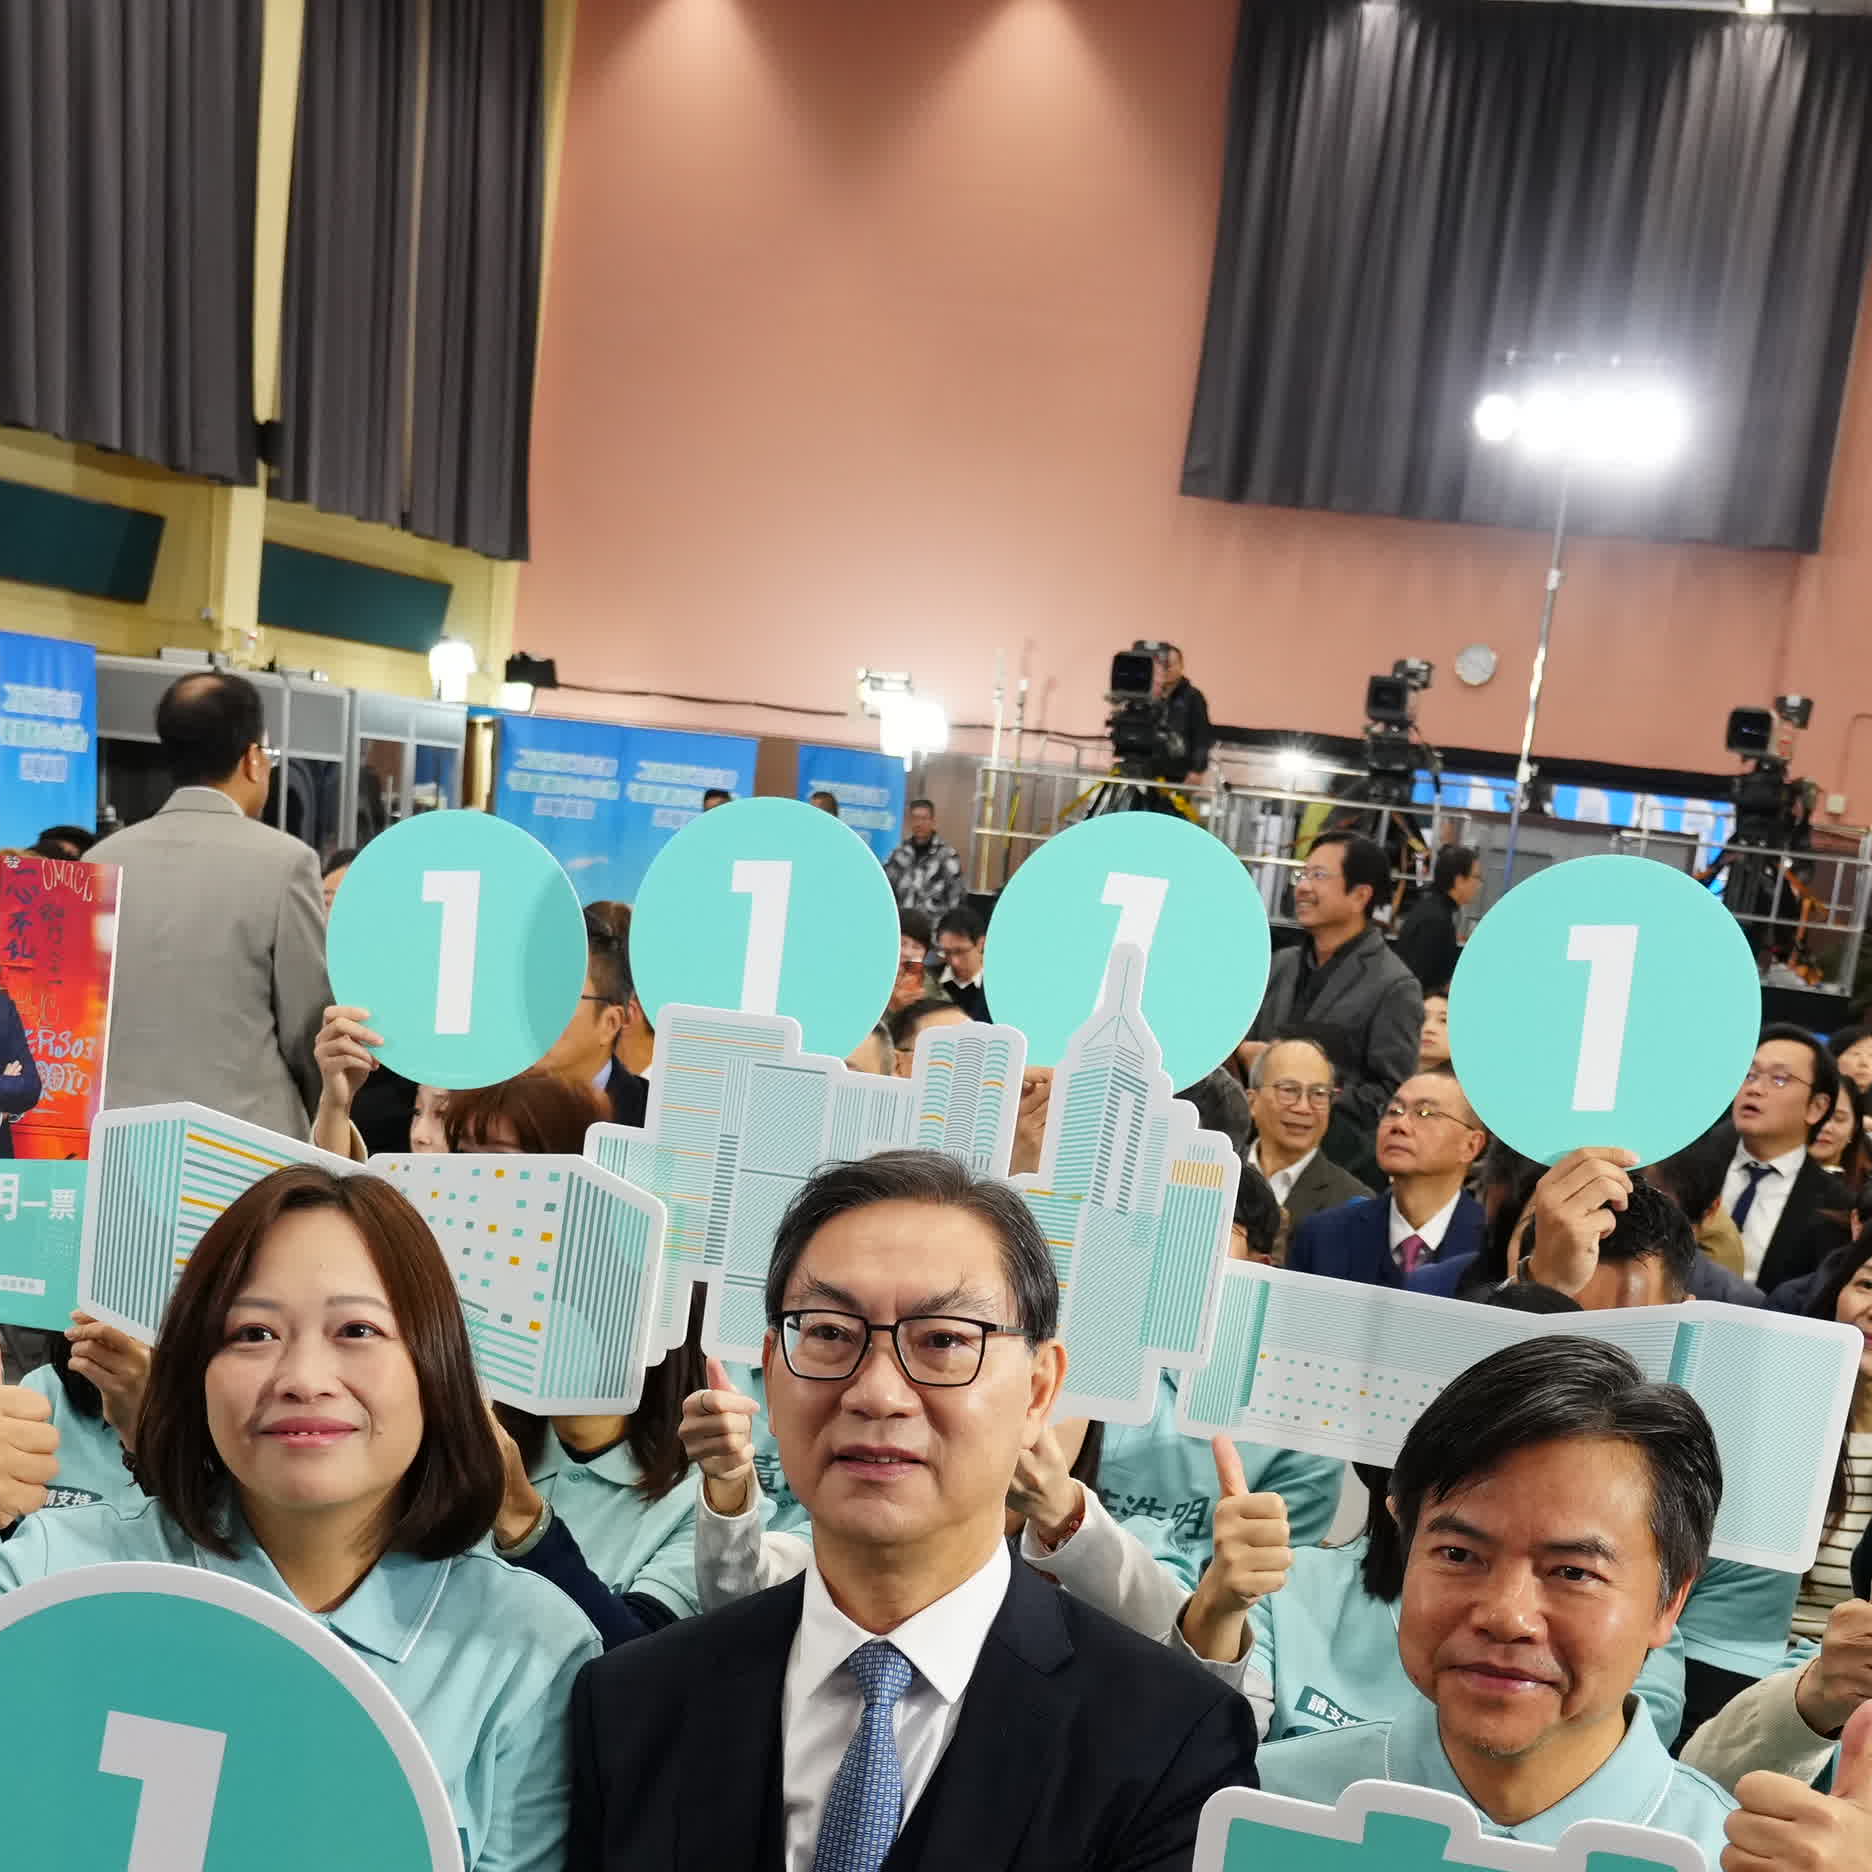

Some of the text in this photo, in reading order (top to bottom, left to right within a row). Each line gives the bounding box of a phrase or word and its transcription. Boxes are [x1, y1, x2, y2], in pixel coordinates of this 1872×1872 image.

[422, 870, 481, 1034] 1
[731, 860, 793, 1016] 1
[1095, 871, 1170, 1012] 1
[1565, 924, 1640, 1112] 1
[1101, 1488, 1210, 1540] 浩明
